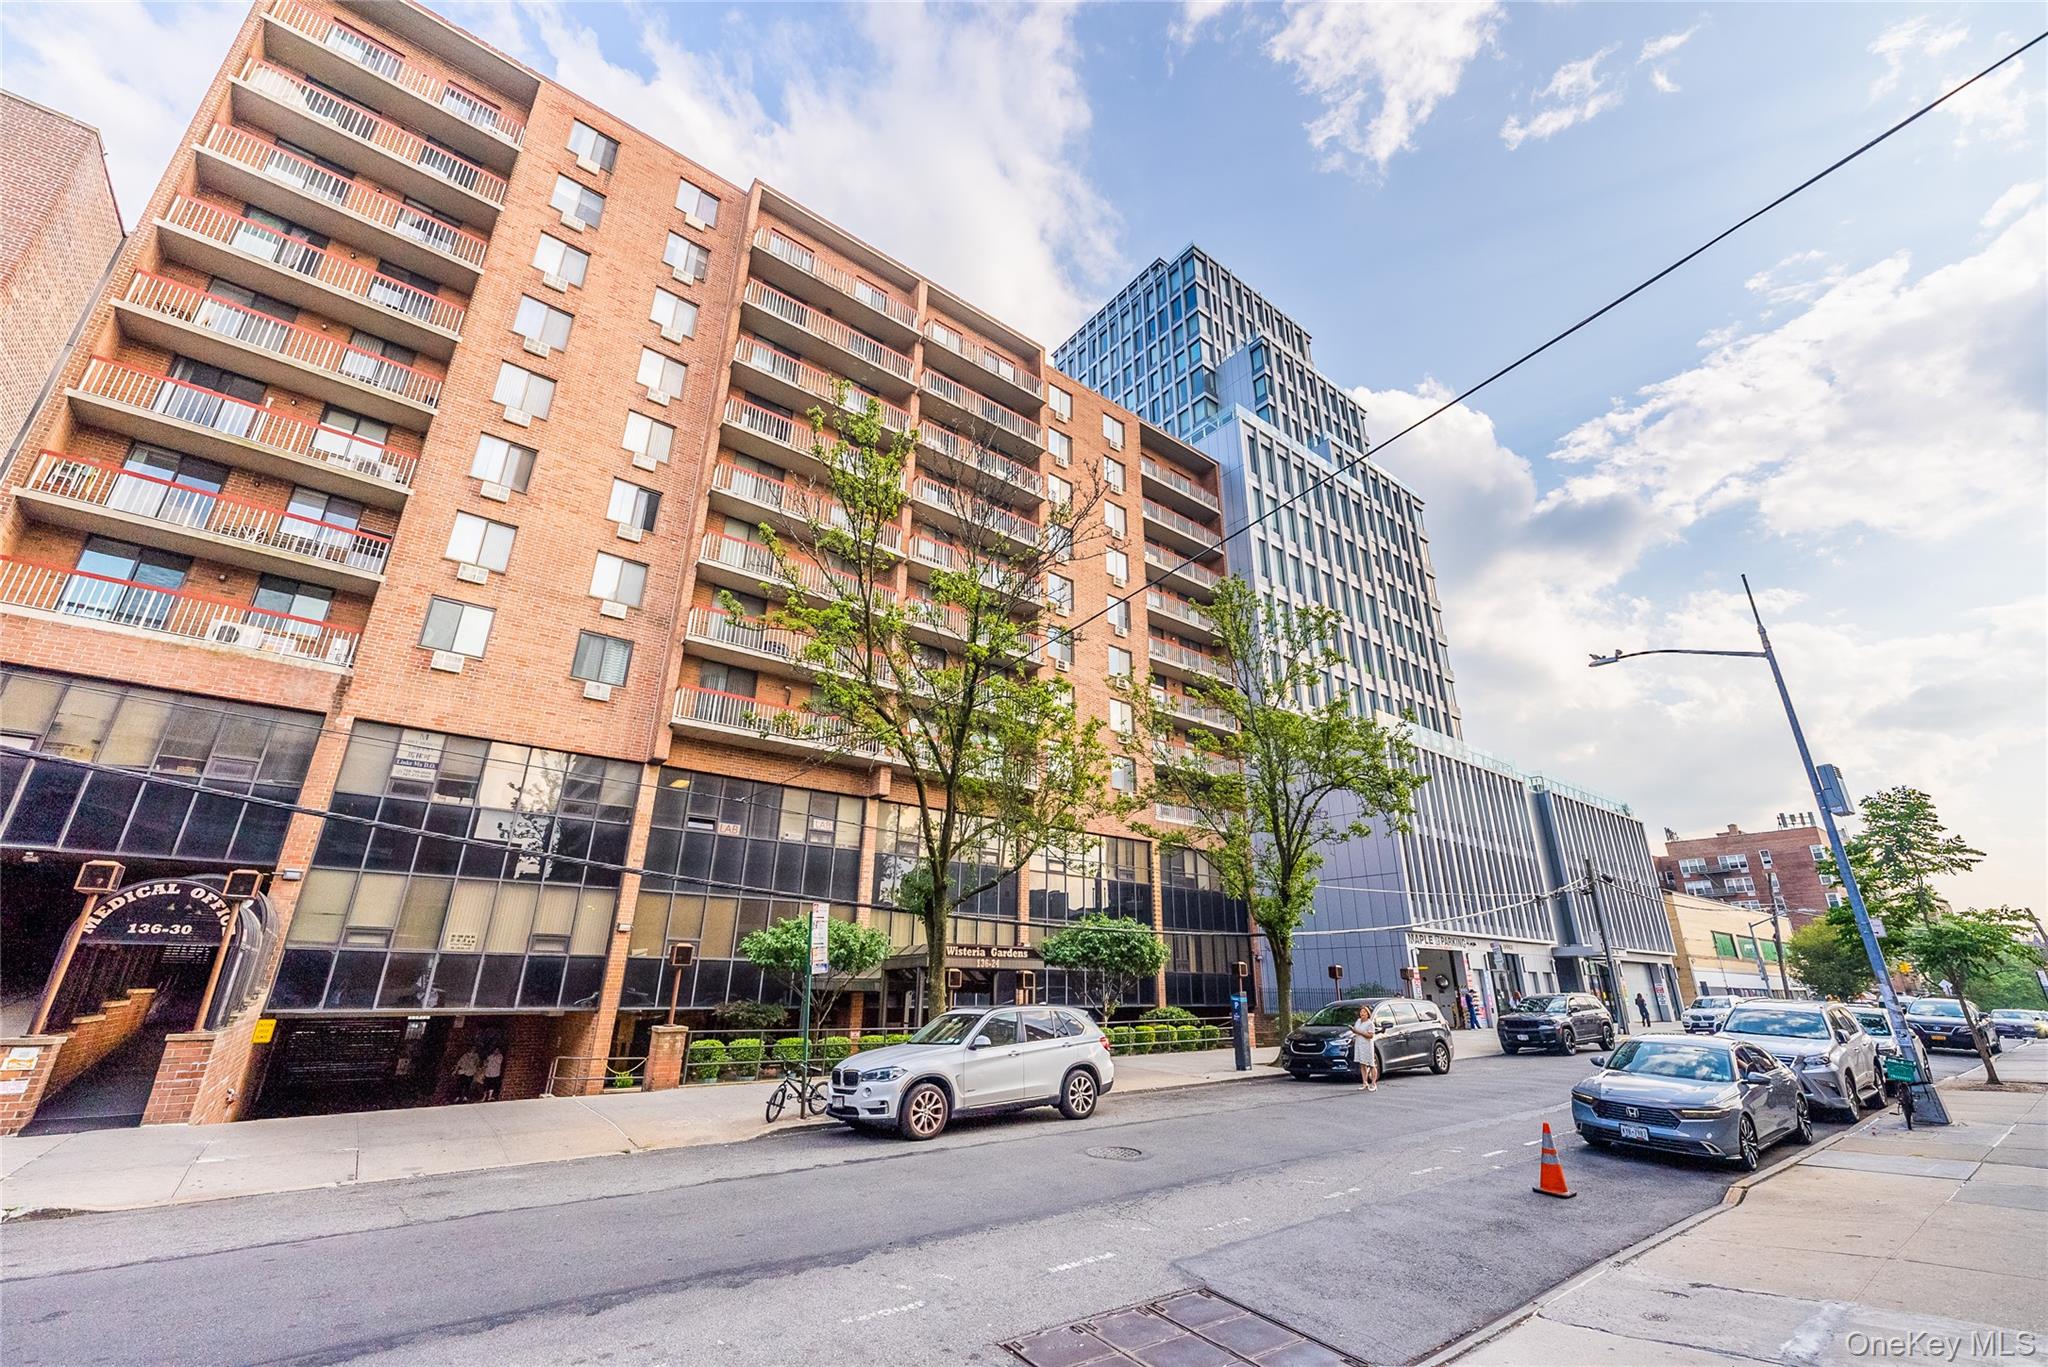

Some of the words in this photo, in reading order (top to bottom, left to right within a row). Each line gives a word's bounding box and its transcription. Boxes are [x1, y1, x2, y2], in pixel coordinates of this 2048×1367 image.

[720, 824, 739, 834] LAB
[815, 820, 832, 830] LAB
[83, 883, 180, 934] MEDICAL
[127, 923, 193, 935] 136-30
[1407, 933, 1433, 945] MAPLE
[1441, 935, 1467, 948] PARKING
[946, 946, 986, 957] Wisteria
[991, 947, 1029, 958] Gardens
[976, 958, 1000, 969] 136-24
